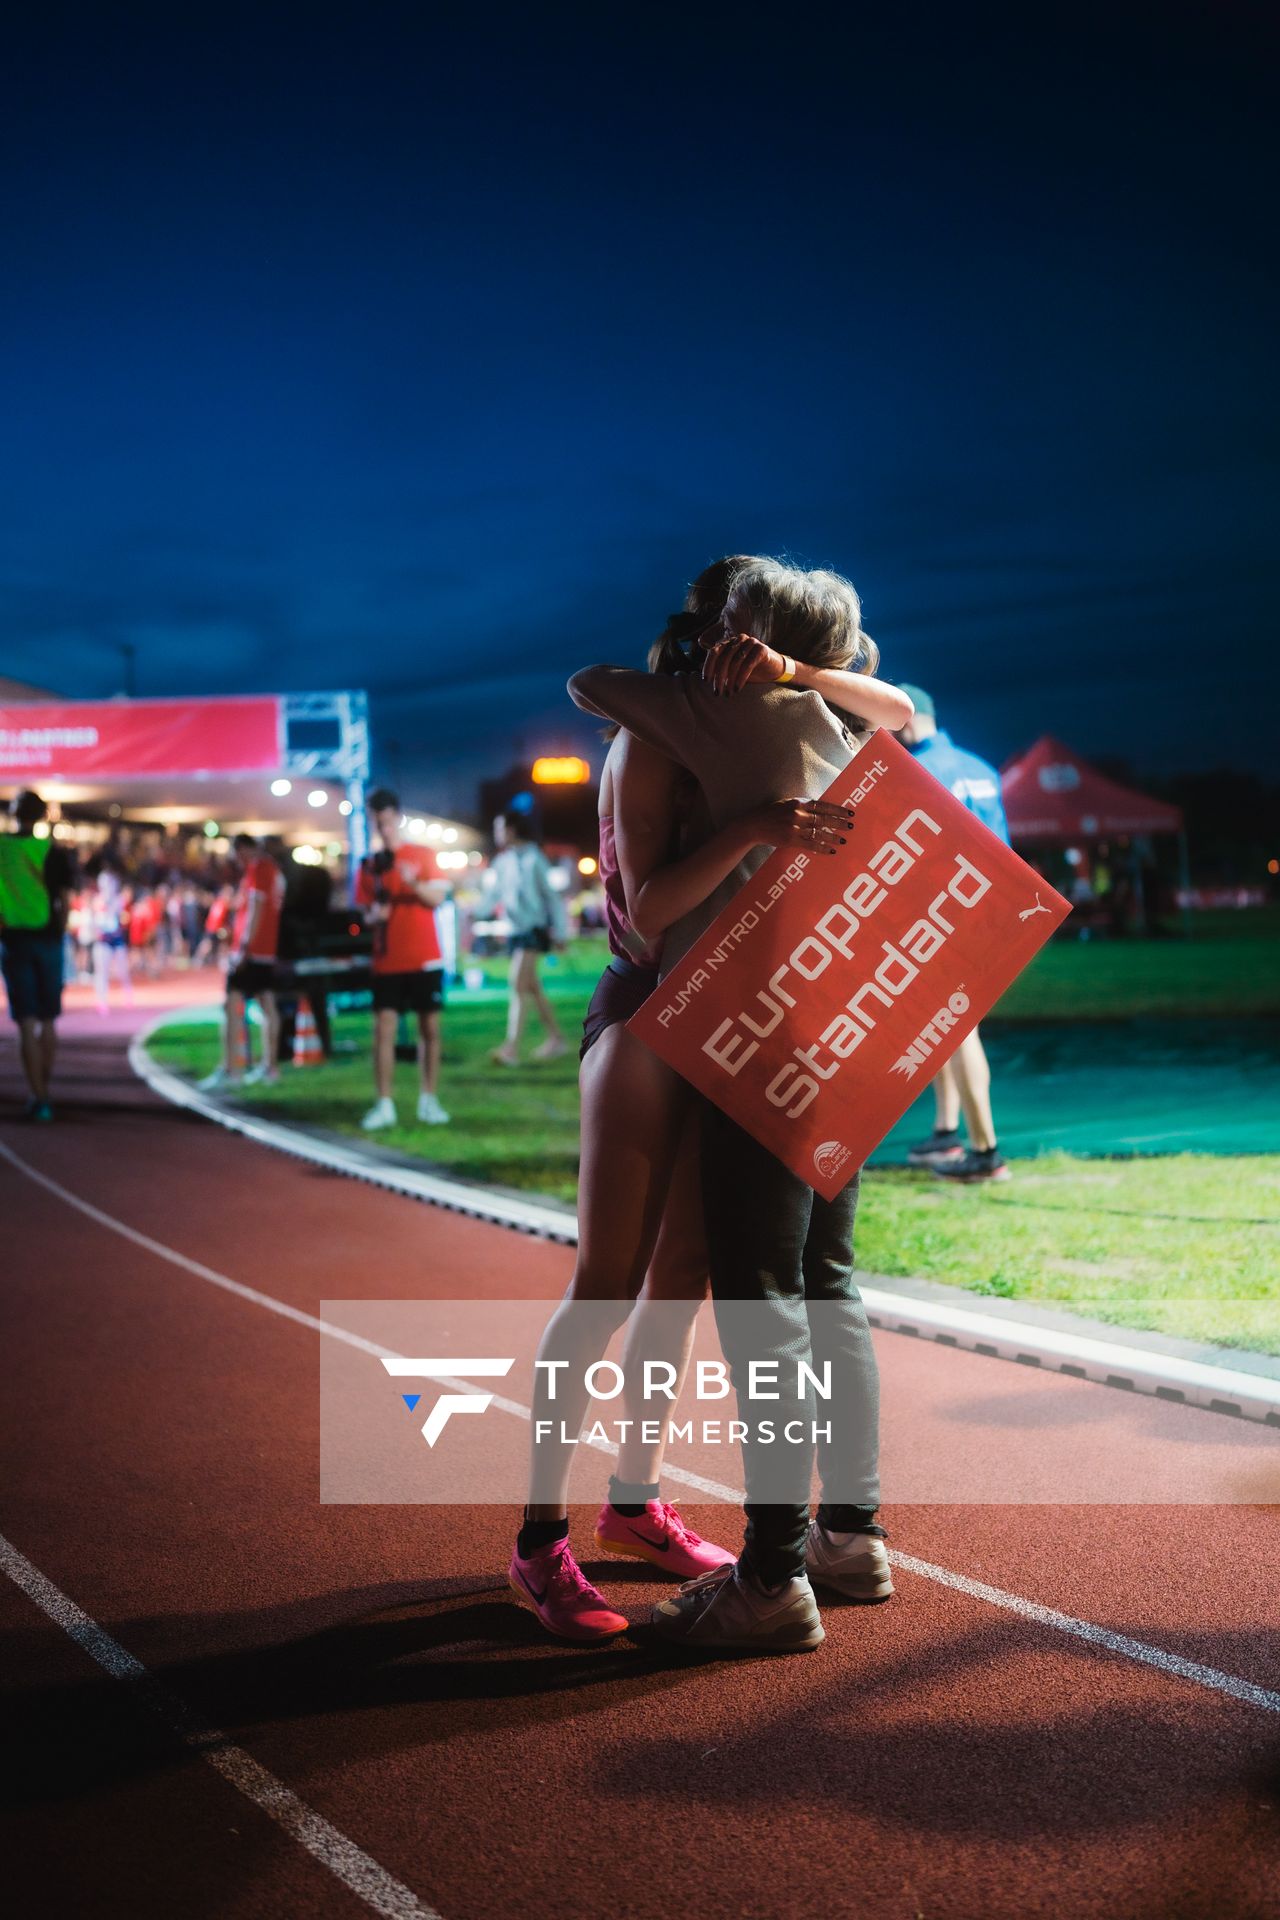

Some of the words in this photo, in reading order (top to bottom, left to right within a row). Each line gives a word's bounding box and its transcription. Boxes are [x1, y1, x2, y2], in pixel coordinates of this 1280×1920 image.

[656, 968, 711, 1028] PUMA
[705, 910, 760, 971] NITRO
[755, 853, 811, 912] Lange
[701, 808, 942, 1077] European
[765, 853, 993, 1119] Standard
